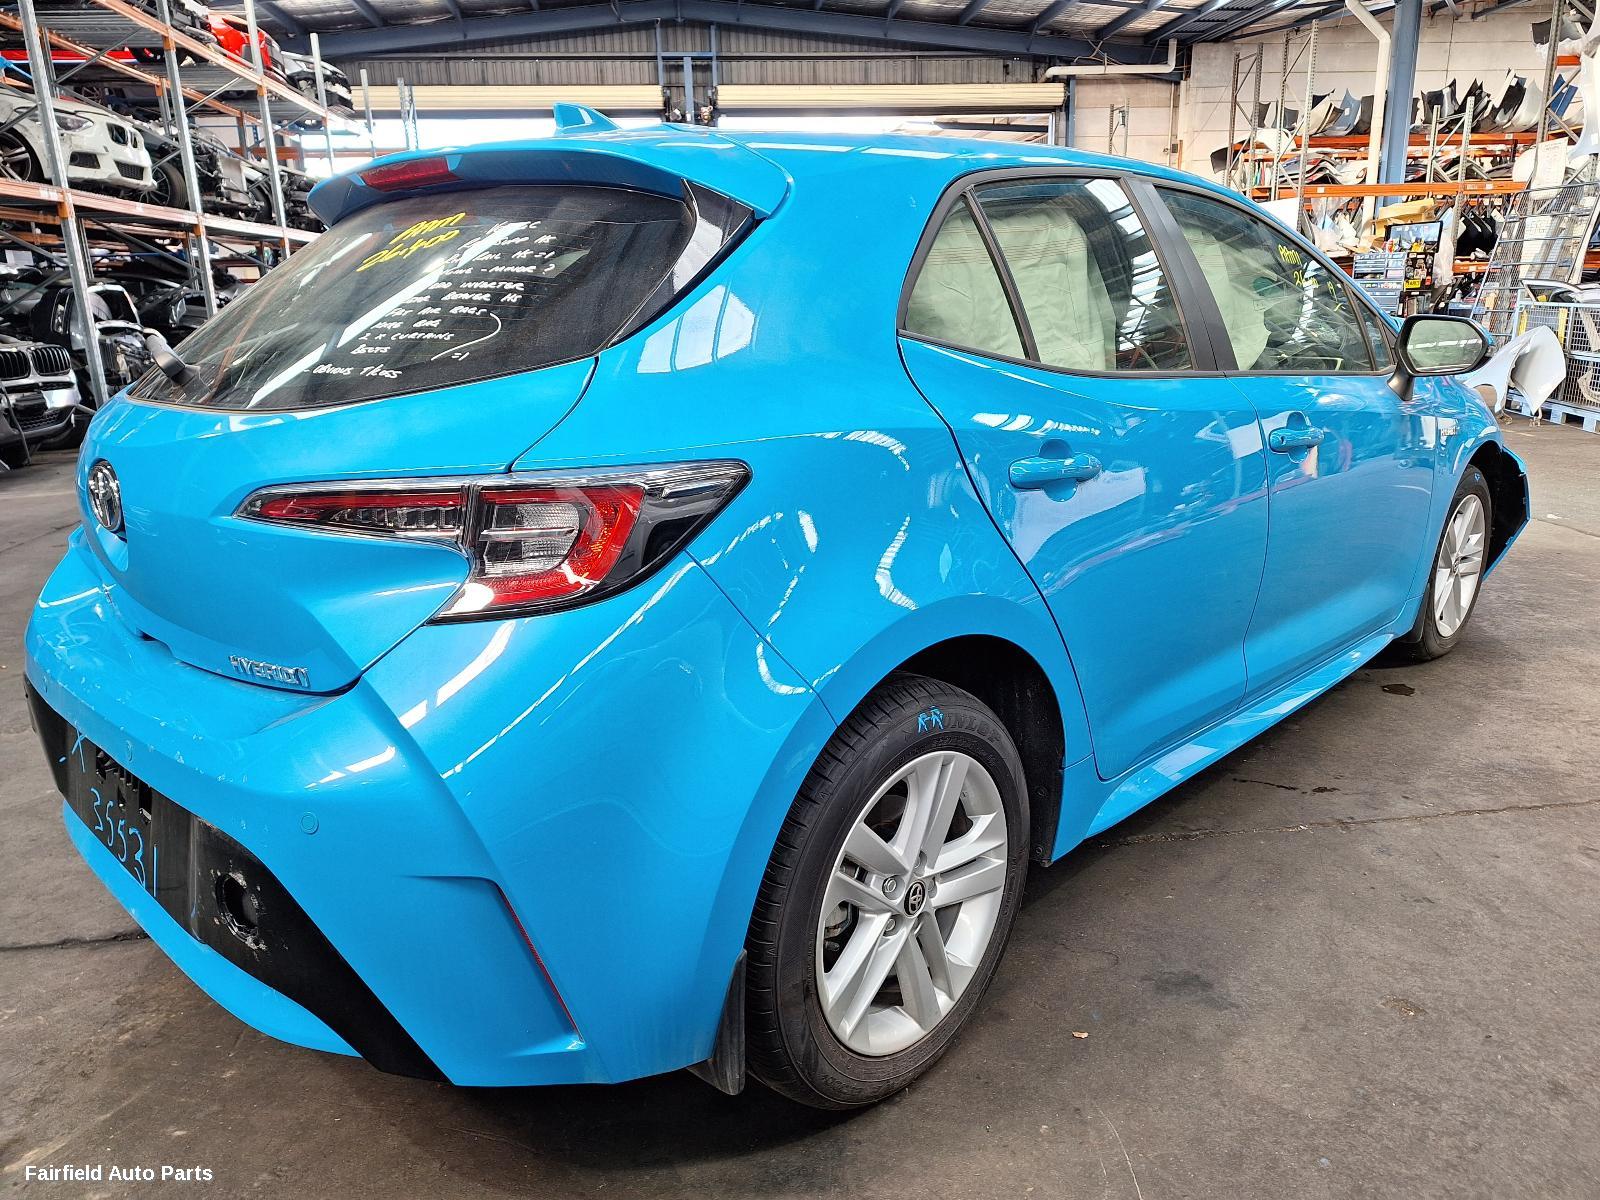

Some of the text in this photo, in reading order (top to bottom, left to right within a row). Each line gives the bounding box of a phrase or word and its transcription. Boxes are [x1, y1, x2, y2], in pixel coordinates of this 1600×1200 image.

[488, 265, 537, 274] MINOR
[460, 280, 525, 291] INVERTER
[417, 305, 442, 316] AIR
[449, 304, 488, 316] BAGS
[390, 331, 455, 342] CURTAINS
[349, 342, 392, 355] BELTS
[312, 362, 354, 375] OBVIOUS
[228, 655, 311, 689] HYBRID
